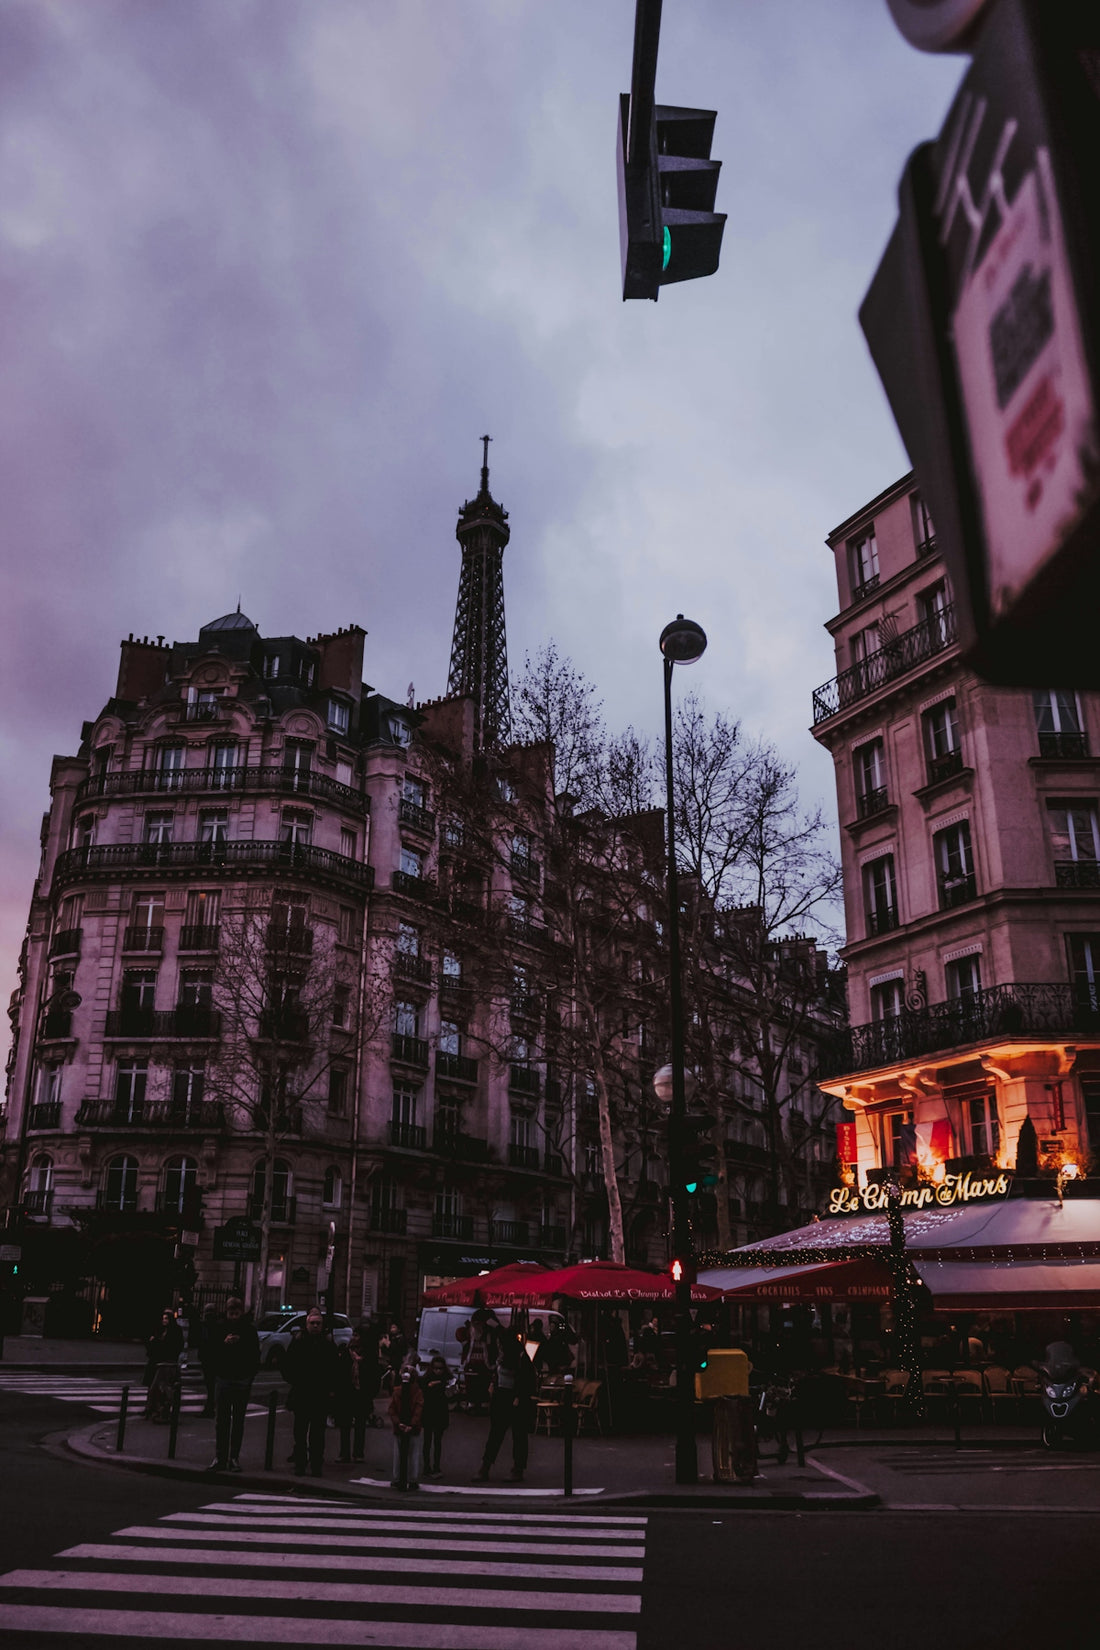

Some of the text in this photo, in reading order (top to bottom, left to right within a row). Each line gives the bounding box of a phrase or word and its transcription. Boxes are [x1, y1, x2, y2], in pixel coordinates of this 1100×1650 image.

[828, 1186, 859, 1213] Le
[858, 1183, 933, 1209] Chmp
[943, 1171, 1008, 1201] Mars
[580, 1288, 707, 1301] Bistrot Le Champ de ars
[756, 1286, 800, 1296] COCKTAILS
